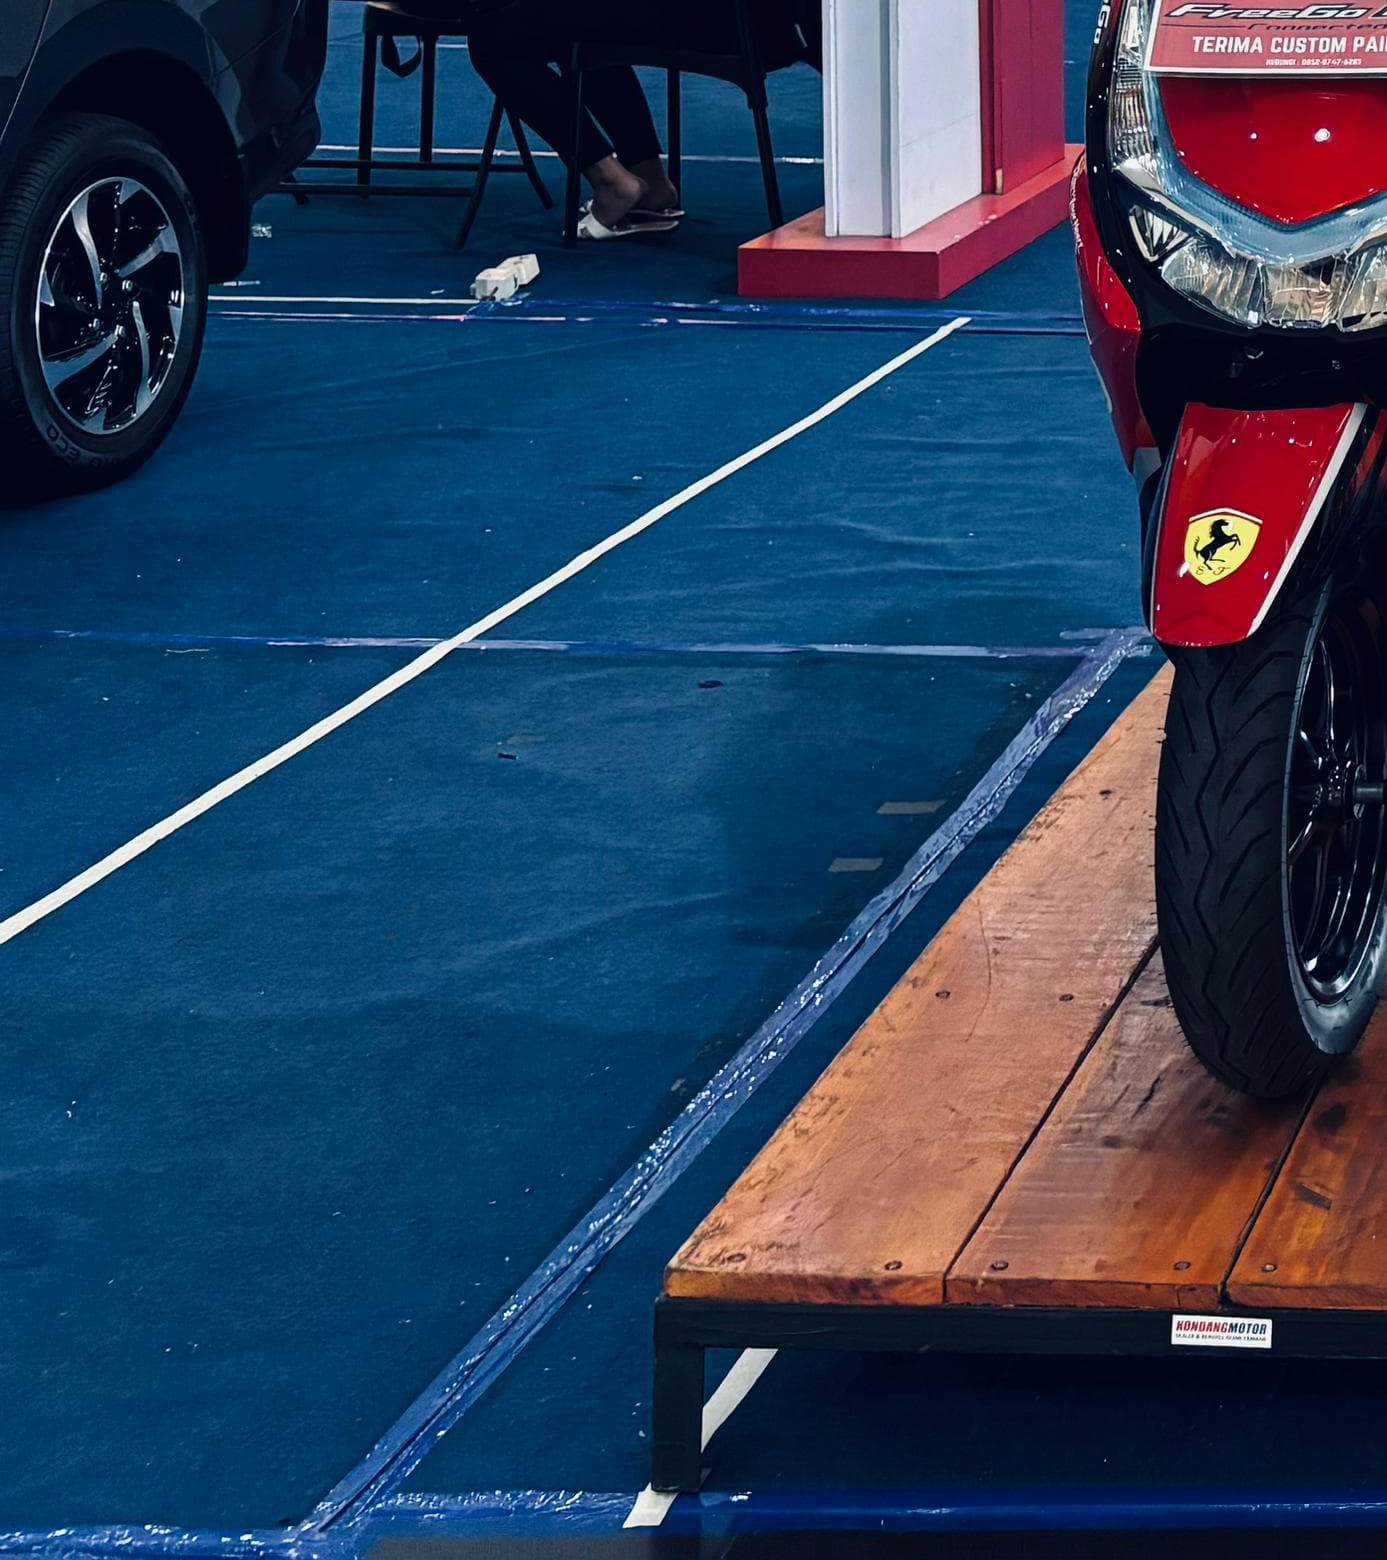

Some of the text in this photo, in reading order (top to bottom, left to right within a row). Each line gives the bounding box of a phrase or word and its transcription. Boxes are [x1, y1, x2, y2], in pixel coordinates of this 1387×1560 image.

[1166, 3, 1372, 20] FreeGo
[1192, 36, 1263, 53] TERIMA
[1270, 36, 1347, 53] CUSTOM
[1176, 1320, 1267, 1335] KONDANGMOTOR
